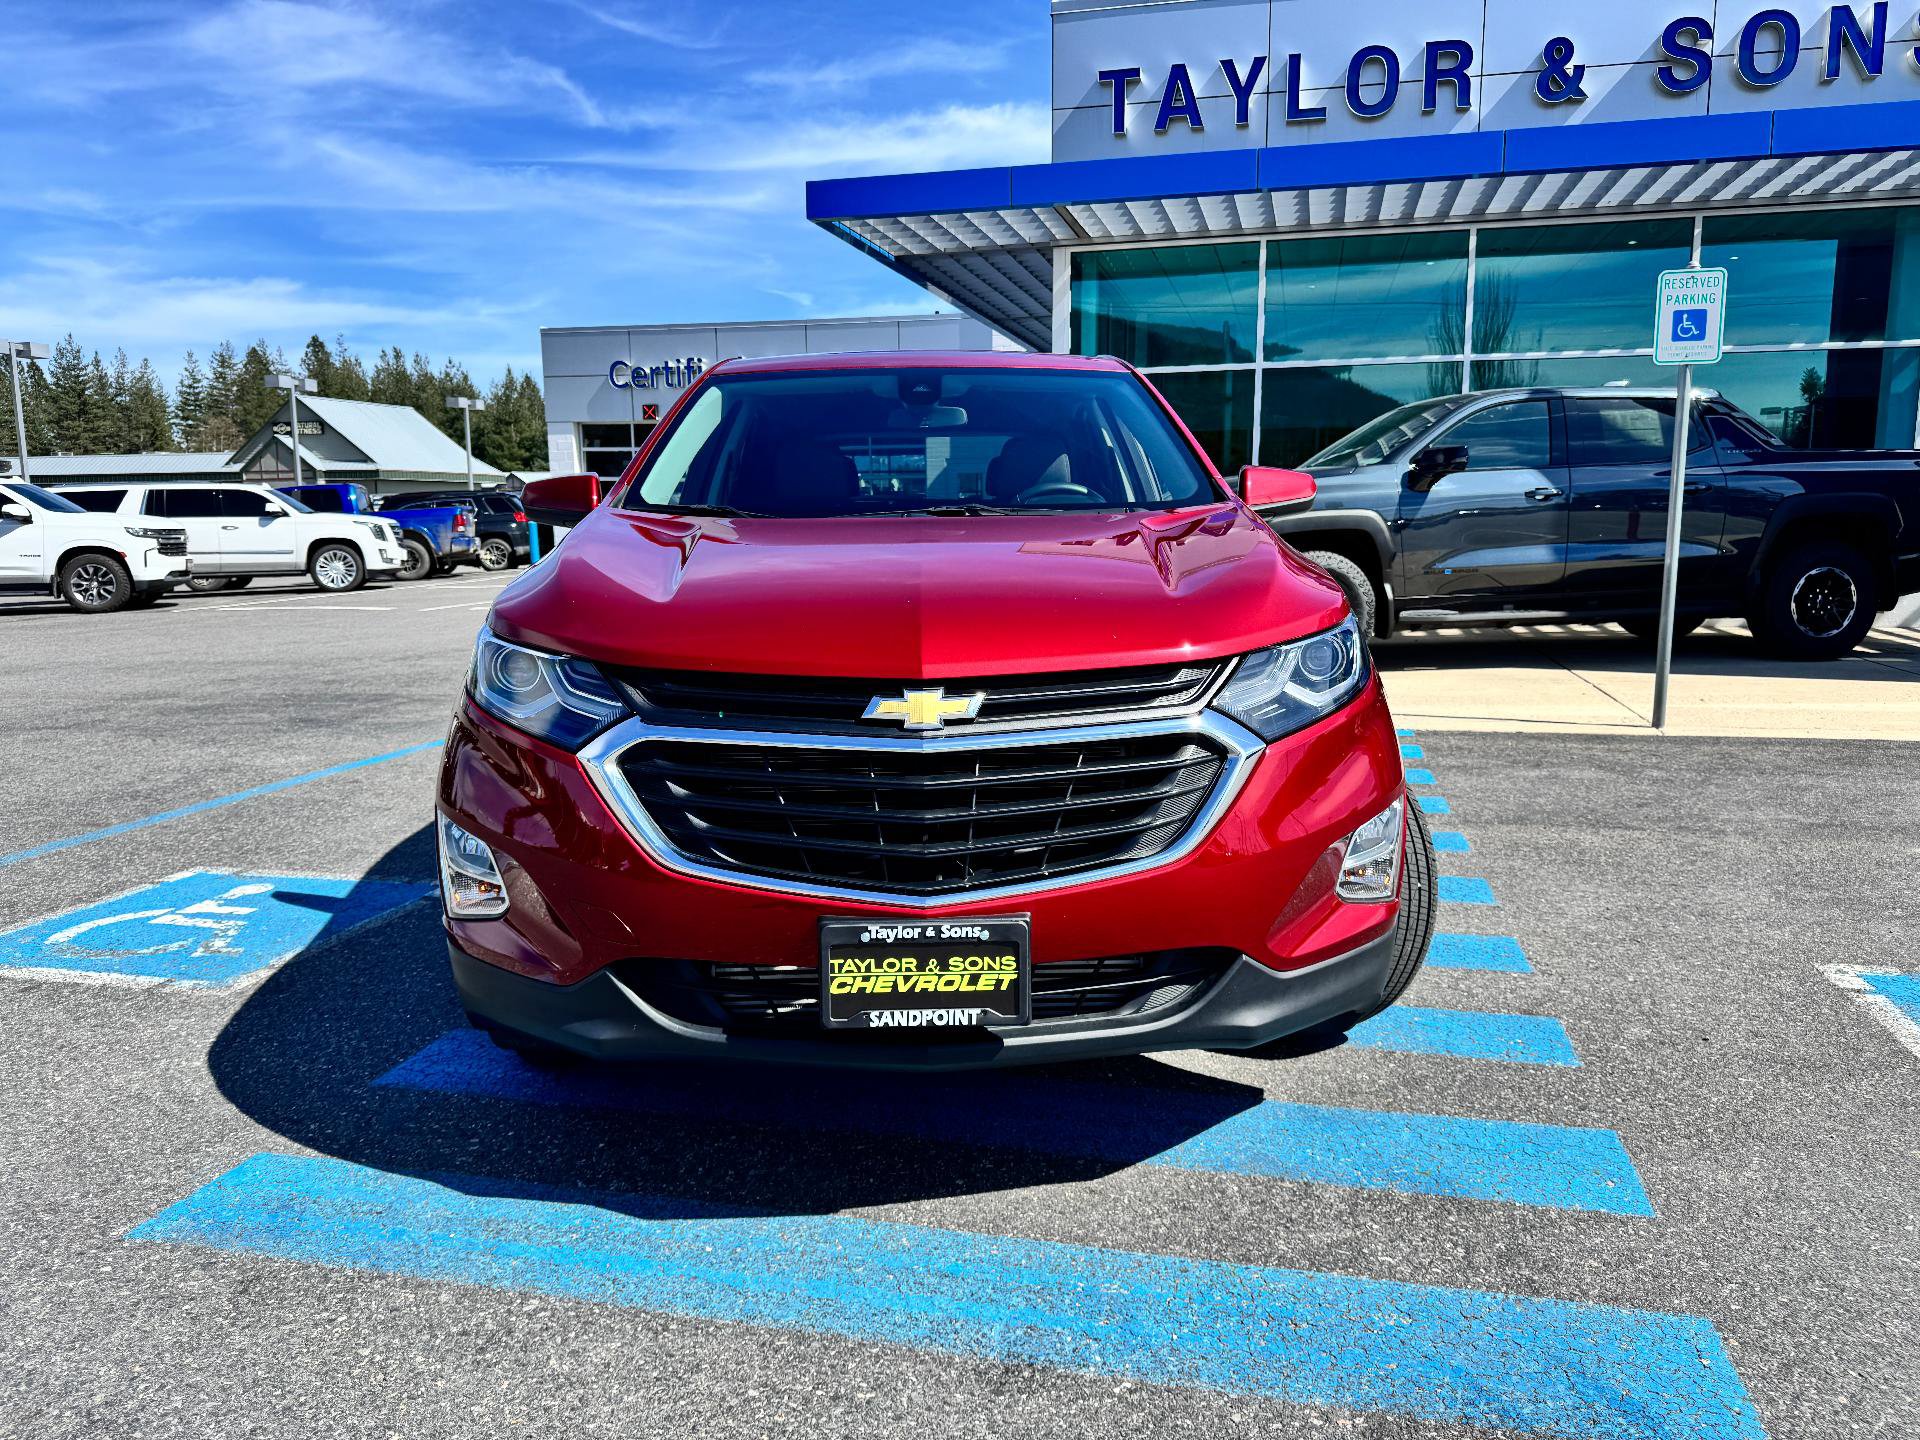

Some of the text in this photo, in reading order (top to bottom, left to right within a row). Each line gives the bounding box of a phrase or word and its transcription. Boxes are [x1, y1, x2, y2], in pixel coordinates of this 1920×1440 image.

[1098, 1, 1920, 136] TAYLOR & SON
[1664, 276, 1720, 289] RESERVED
[1666, 292, 1716, 305] PARKING
[608, 357, 702, 389] Certifi
[868, 925, 980, 943] Taylor & Sons
[830, 955, 1017, 975] TAYLOR & SONS
[830, 974, 1018, 995] CHEVROLET
[869, 1009, 984, 1028] SANDPOINT
